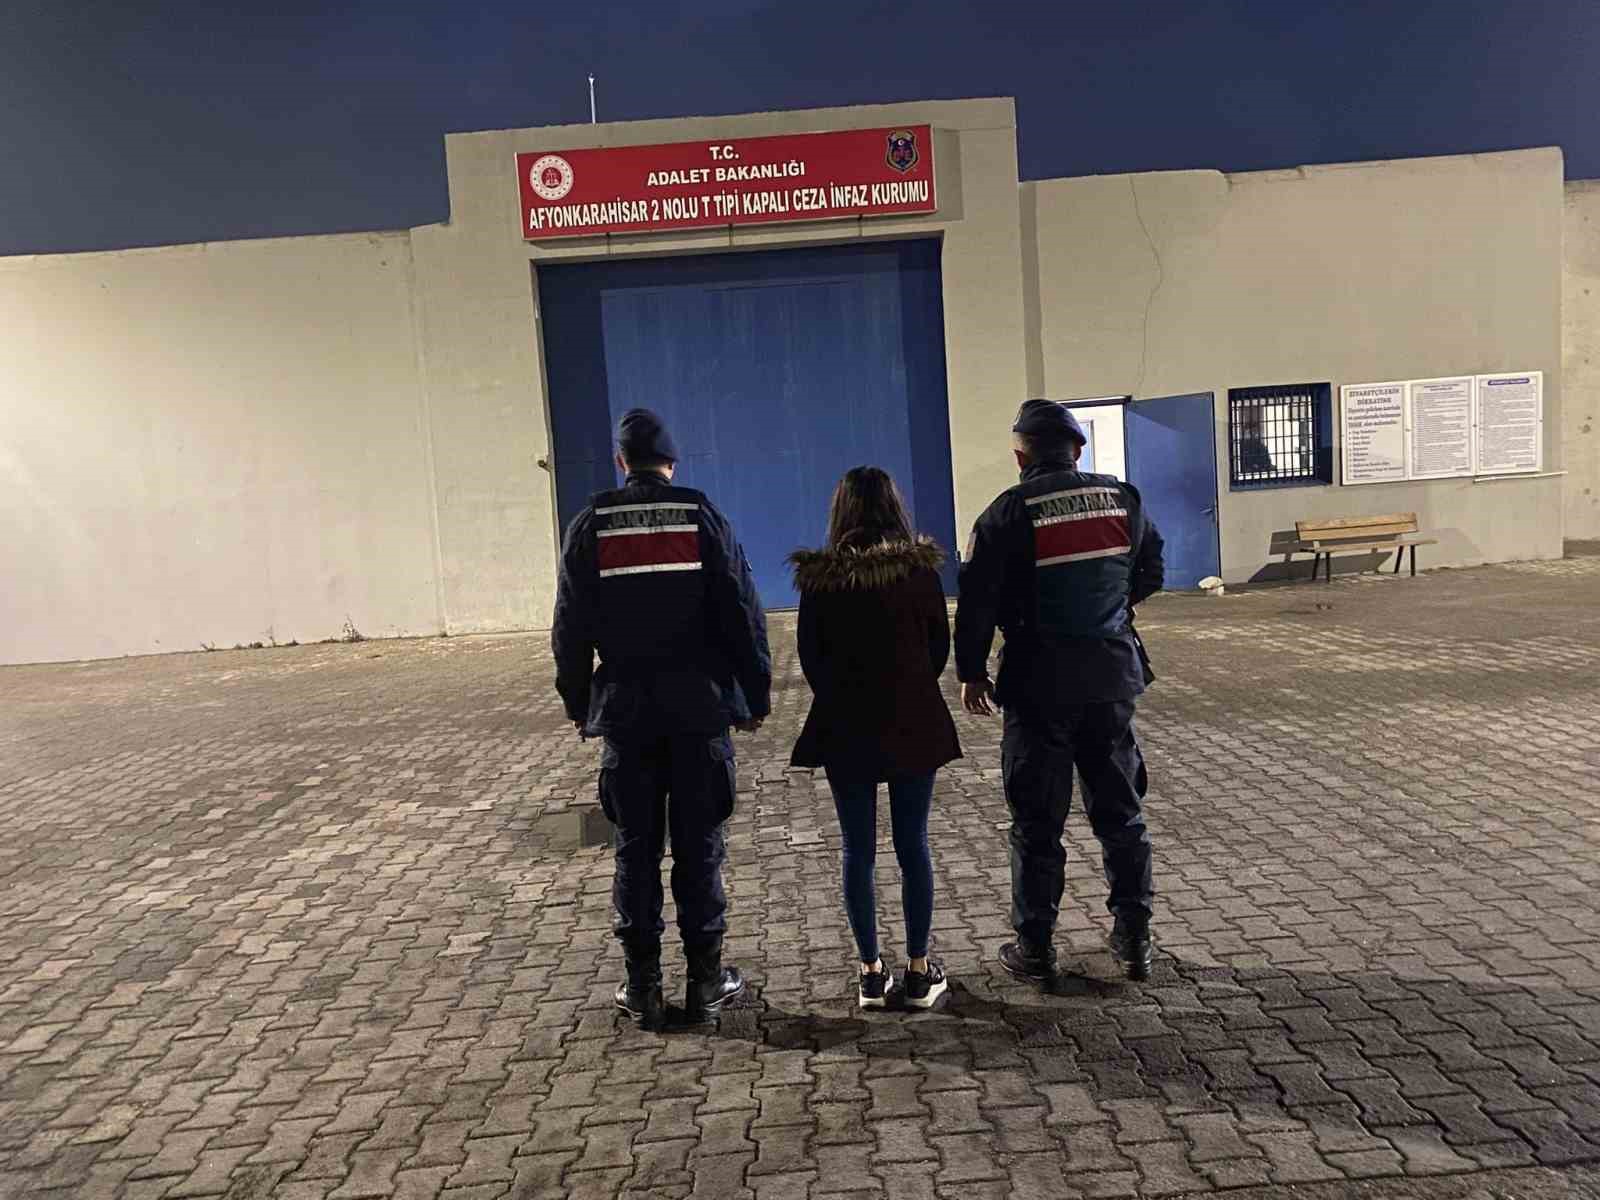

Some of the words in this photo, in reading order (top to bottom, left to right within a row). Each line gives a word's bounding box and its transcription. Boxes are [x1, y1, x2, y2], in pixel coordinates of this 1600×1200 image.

[709, 145, 739, 160] T.C.
[647, 169, 710, 186] ADALET
[715, 160, 805, 182] BAKANLIĞI
[529, 197, 648, 229] AFYONKARAHİSAR
[652, 199, 660, 221] 2
[663, 196, 698, 220] NOLU
[702, 196, 710, 217] T
[713, 189, 740, 216] TİPİ
[743, 190, 790, 215] KAPALI
[793, 188, 827, 211] CEZA
[831, 181, 868, 208] İNFAZ
[872, 180, 929, 206] KURUMU
[1039, 492, 1117, 518] JANDARMA
[608, 509, 688, 528] JANDARMA
